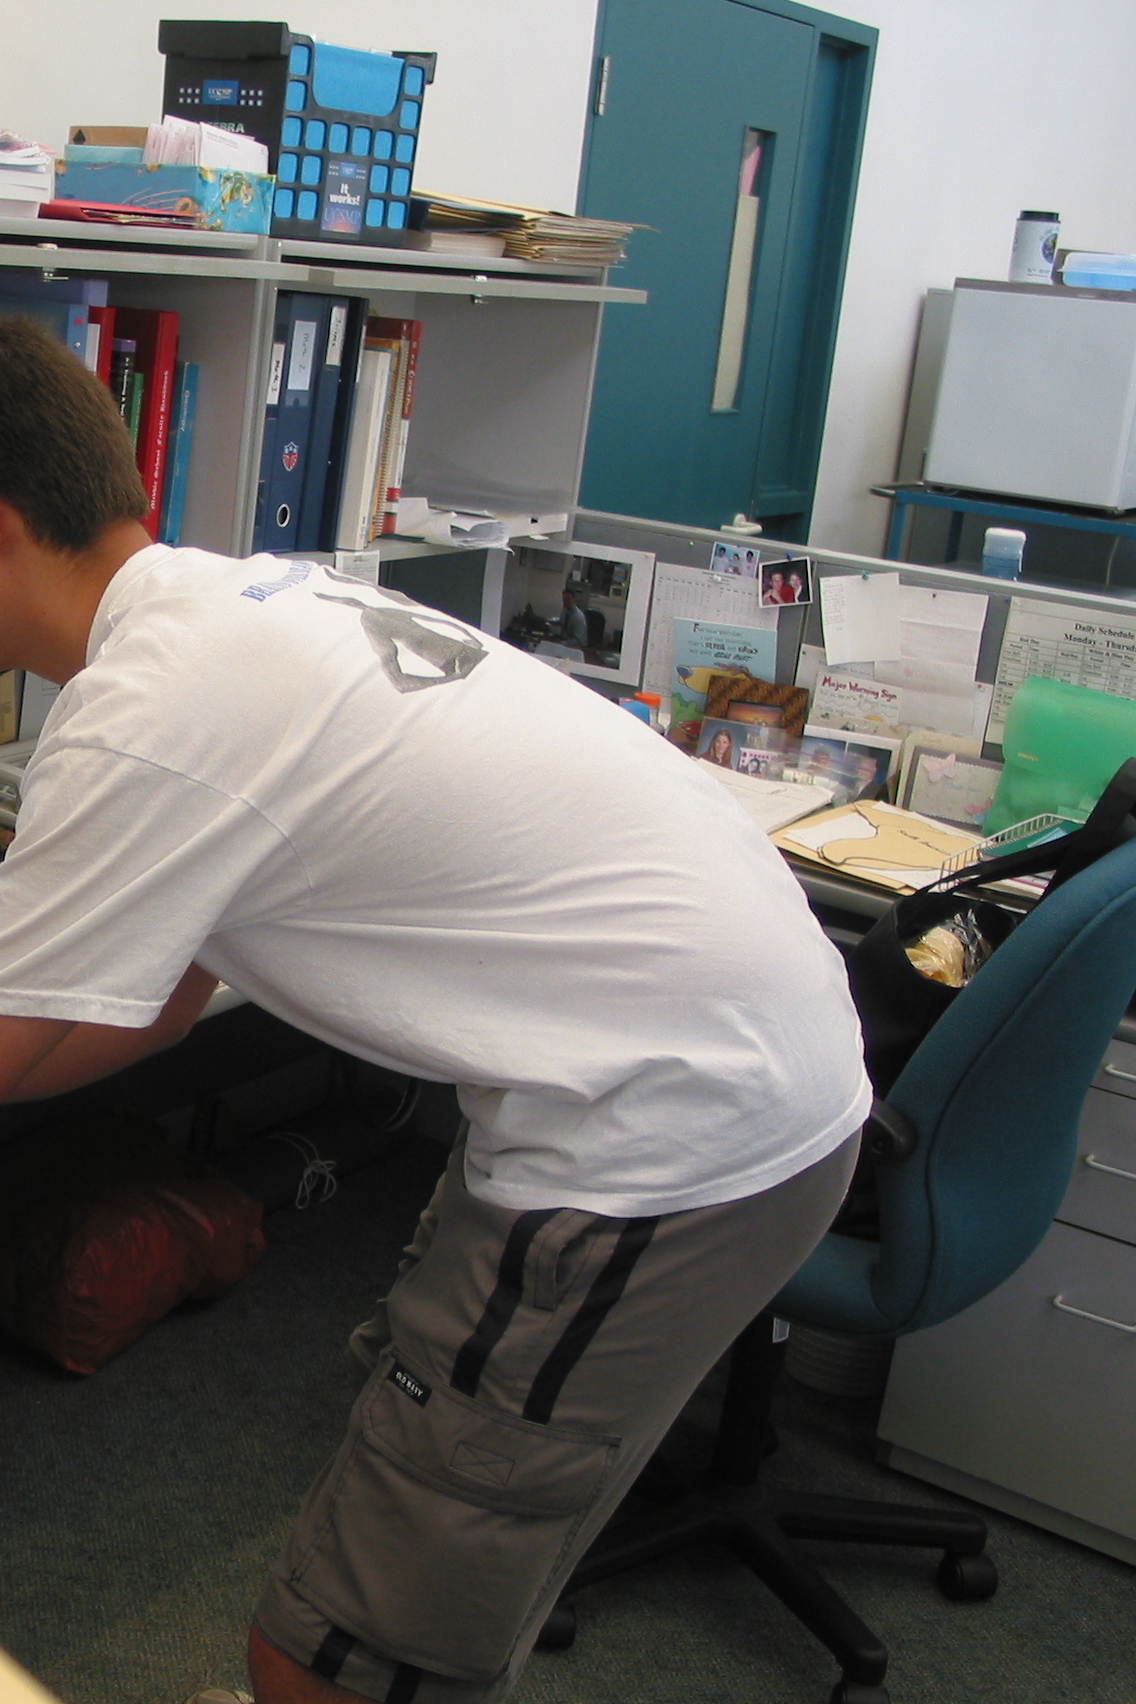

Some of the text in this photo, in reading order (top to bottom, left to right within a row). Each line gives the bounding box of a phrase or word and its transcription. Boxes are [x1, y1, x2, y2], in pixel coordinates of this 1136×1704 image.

[329, 193, 361, 206] works!
[1074, 622, 1135, 640] Daily Schedule
[1064, 633, 1097, 647] Monday
[821, 675, 847, 691] Major
